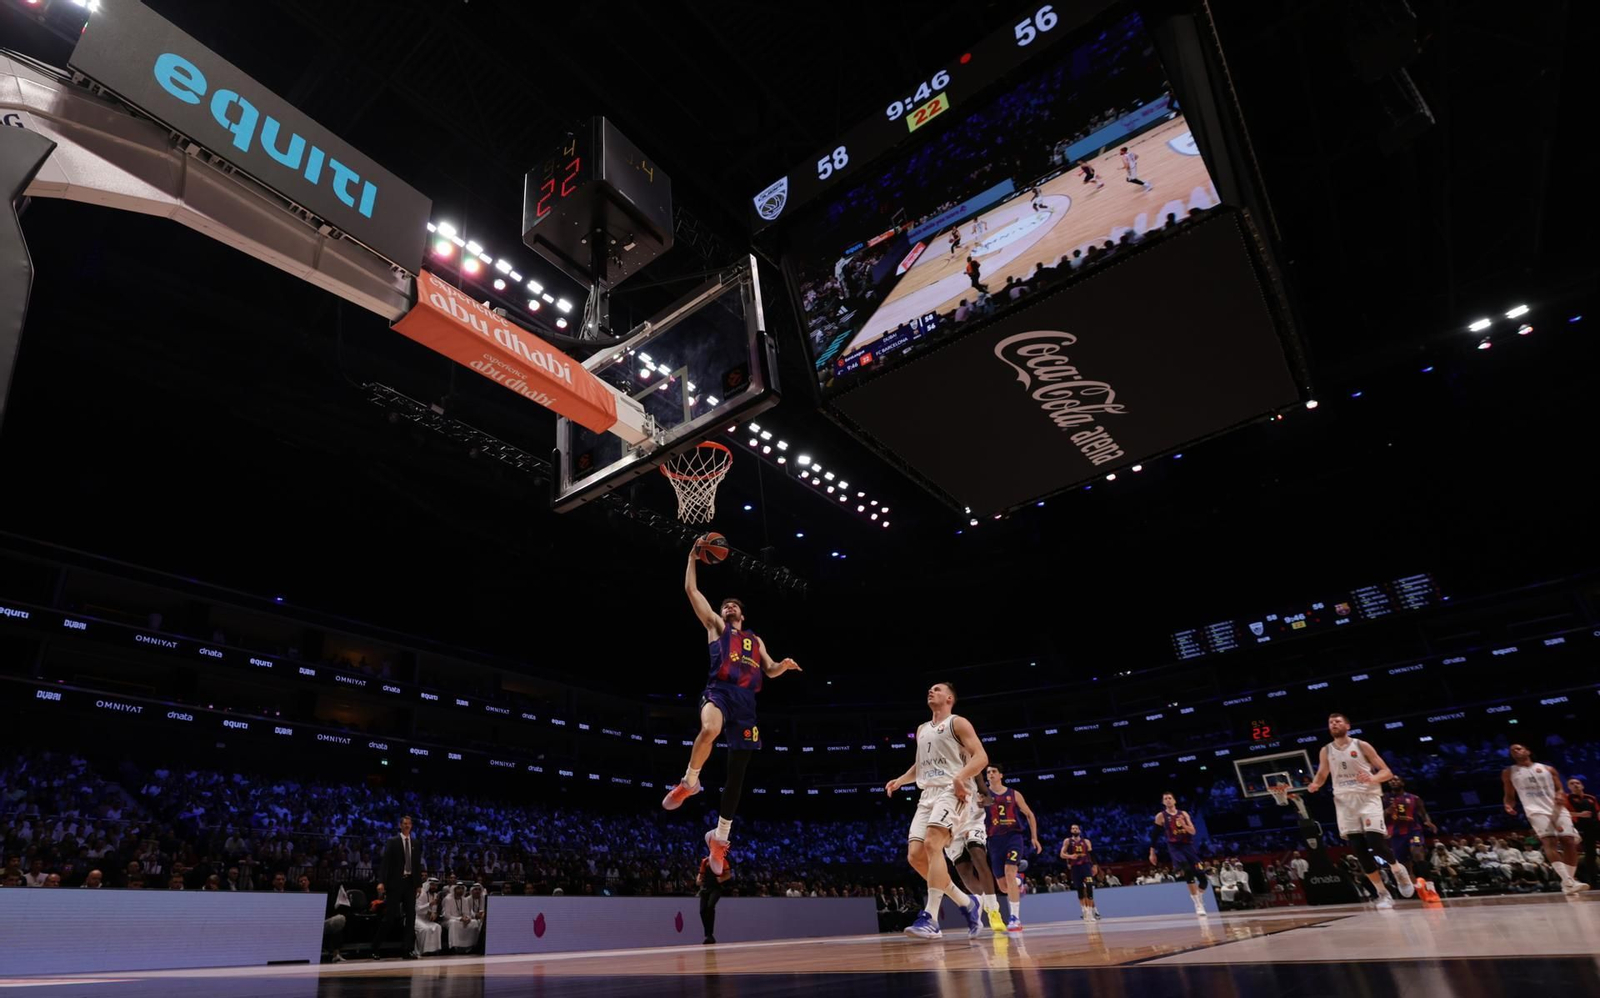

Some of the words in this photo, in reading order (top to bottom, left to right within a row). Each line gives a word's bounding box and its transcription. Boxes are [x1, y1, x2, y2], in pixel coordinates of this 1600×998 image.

[1014, 4, 1058, 47] 56
[885, 69, 950, 121] 9:46
[913, 98, 943, 127] 22
[816, 145, 849, 181] 58
[536, 157, 580, 218] 22
[429, 276, 508, 326] experience
[430, 291, 489, 336] abu
[494, 326, 572, 385] dhabi
[482, 353, 528, 379] experience
[470, 358, 505, 382] abu
[505, 377, 556, 408] dhabi
[994, 330, 1129, 427] Coca-Cola
[1070, 426, 1125, 466] arena
[136, 635, 178, 648] OMNIYAT
[743, 638, 752, 652] 8
[199, 648, 223, 658] dnata
[1492, 647, 1518, 655] equiti
[250, 658, 272, 667] equiti
[1443, 657, 1466, 665] dnata
[1388, 664, 1424, 675] OMNIYAT
[335, 677, 366, 686] OMNIYAT
[96, 700, 143, 713] OMNIYAT
[1223, 696, 1252, 706] OMNIYAT
[1540, 697, 1568, 705] equiti
[167, 711, 193, 721] dnata
[1486, 705, 1512, 714] dnata
[1428, 711, 1465, 723] OMNIYAT
[223, 720, 248, 729] equiti
[317, 733, 351, 744] OMNIYAT
[752, 726, 759, 743] 8
[1252, 726, 1271, 740] 22
[940, 808, 949, 822] 7
[999, 804, 1006, 816] 2
[1009, 850, 1018, 861] 2
[1310, 874, 1341, 885] dnata
